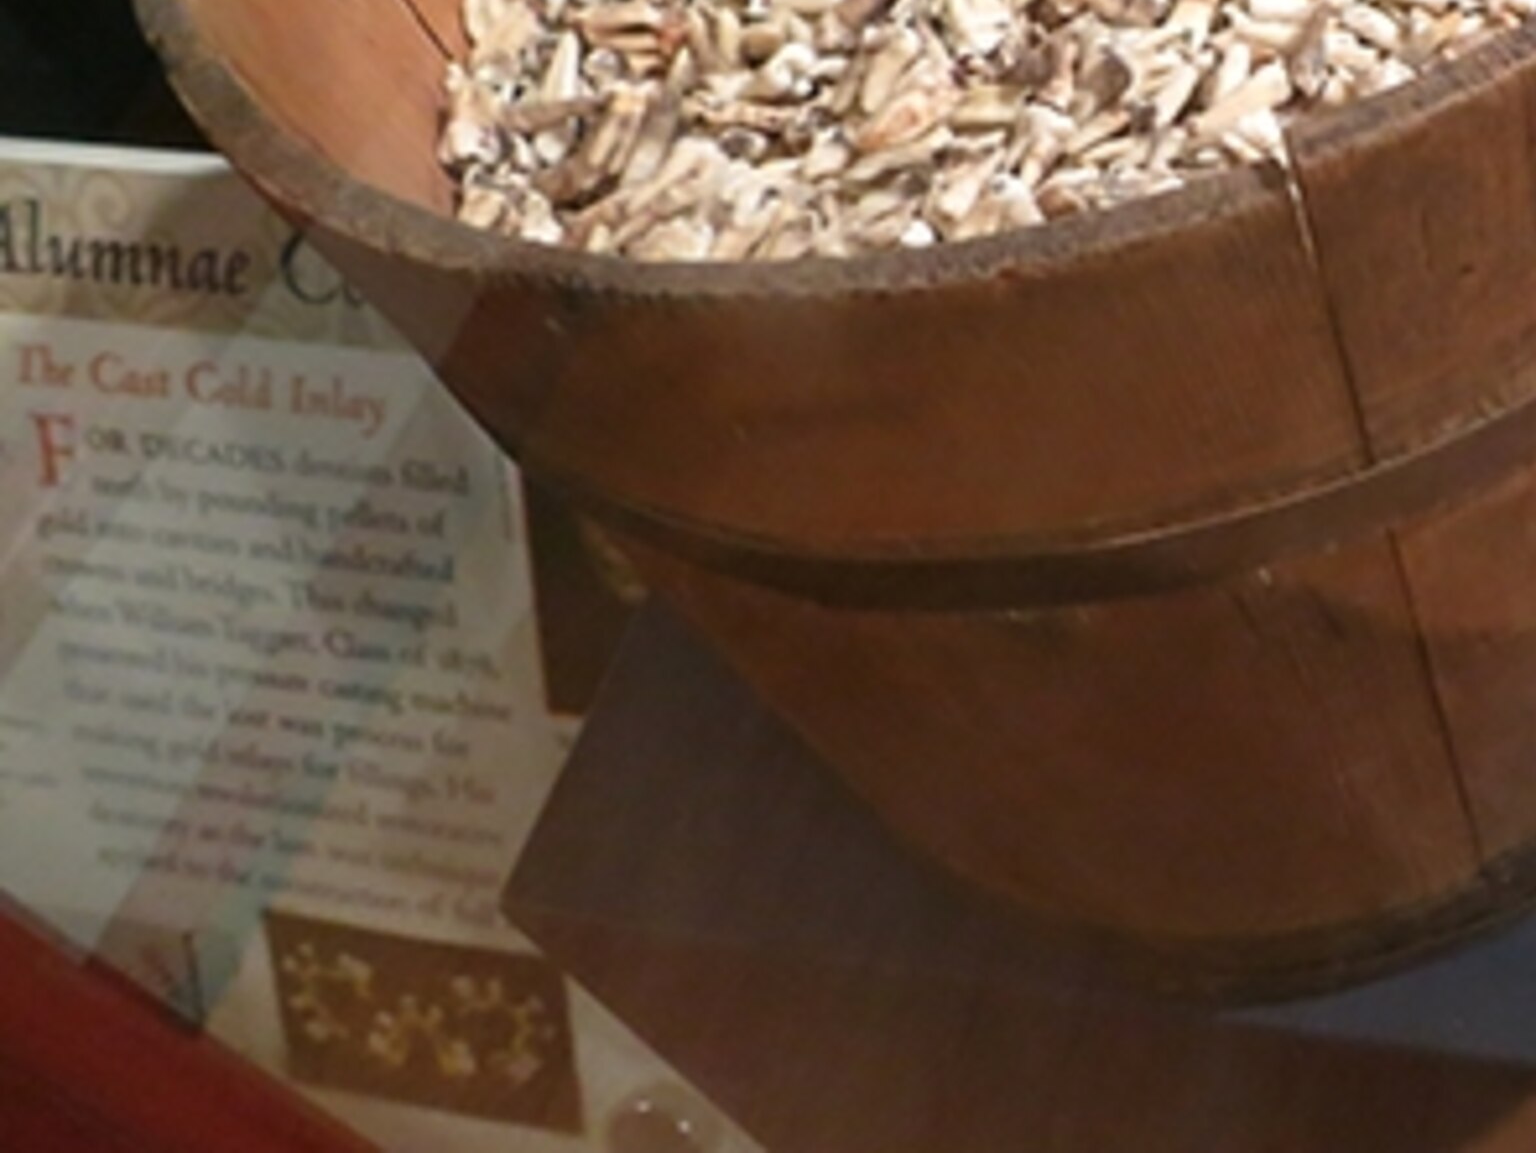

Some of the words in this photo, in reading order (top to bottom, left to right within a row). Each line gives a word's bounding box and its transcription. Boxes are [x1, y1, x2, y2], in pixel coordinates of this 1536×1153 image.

[17, 341, 75, 390] The
[290, 373, 388, 438] Inlay
[140, 431, 286, 477] DECADES
